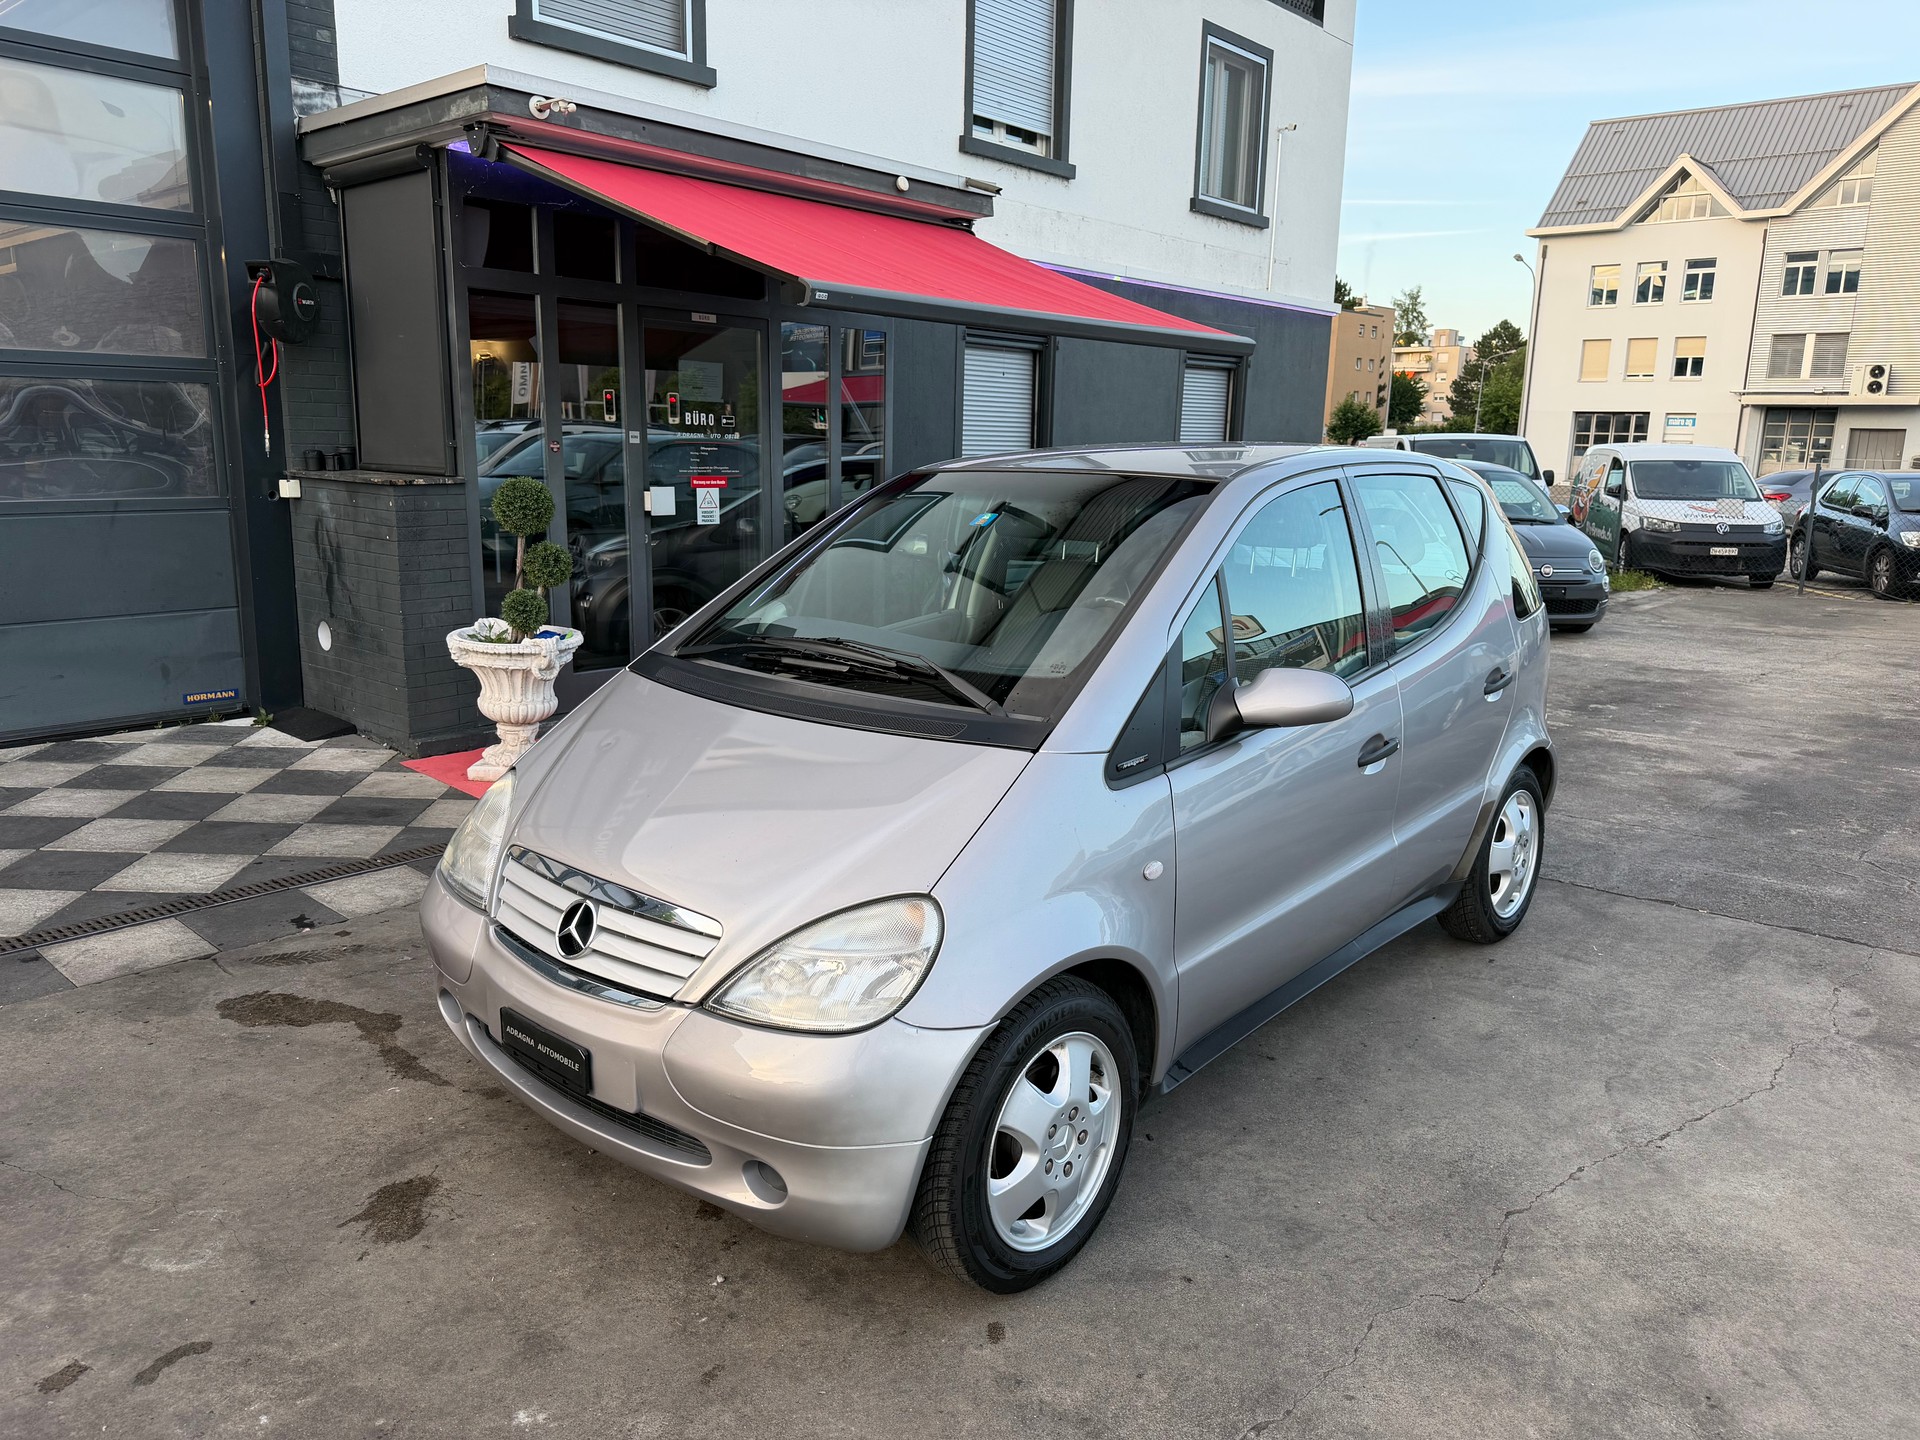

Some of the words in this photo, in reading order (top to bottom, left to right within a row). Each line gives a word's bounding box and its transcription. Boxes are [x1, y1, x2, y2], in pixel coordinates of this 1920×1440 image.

[685, 410, 714, 426] BÜRO
[506, 1026, 535, 1047] ADRAGNA
[538, 1043, 580, 1072] AUTOMOBILE
